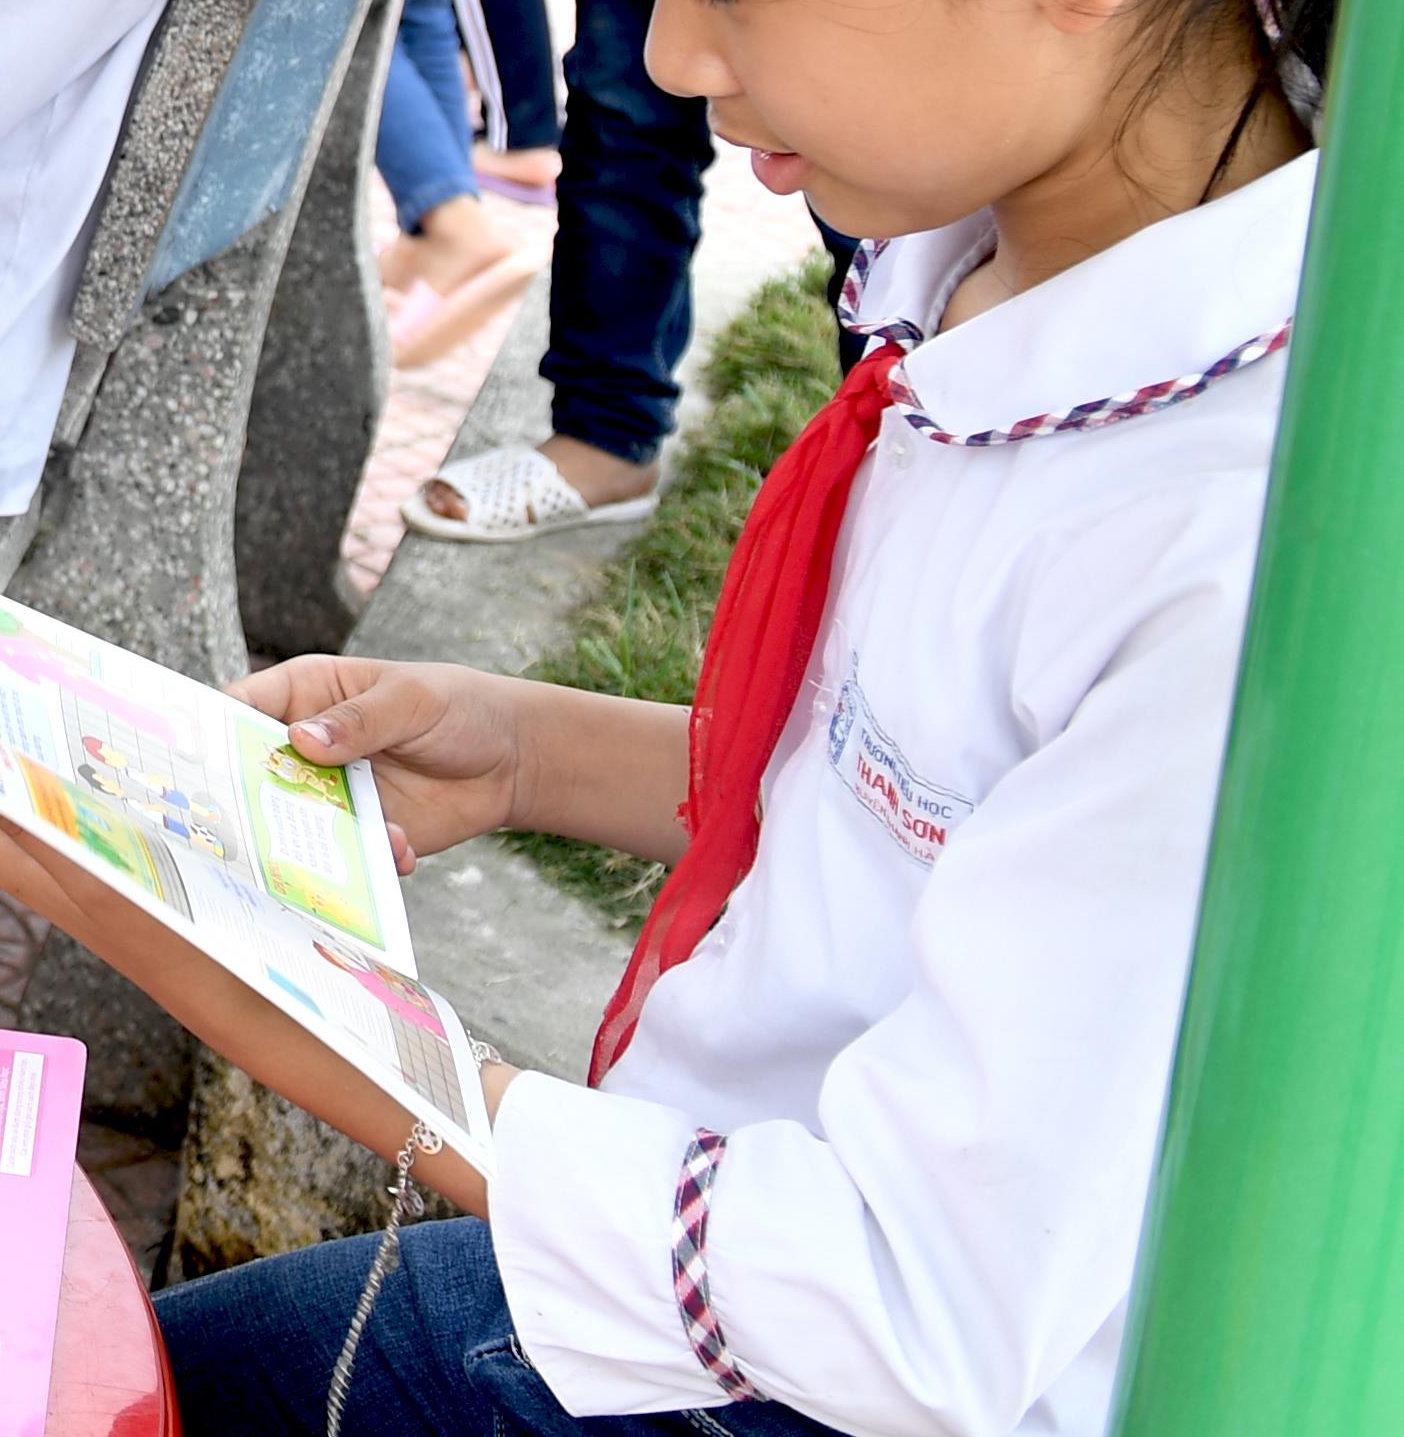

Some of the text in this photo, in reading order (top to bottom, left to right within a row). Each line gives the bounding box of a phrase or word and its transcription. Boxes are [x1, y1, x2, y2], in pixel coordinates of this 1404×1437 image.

[857, 751, 946, 846] THANH SƠN
[917, 795, 953, 820] HỌC
